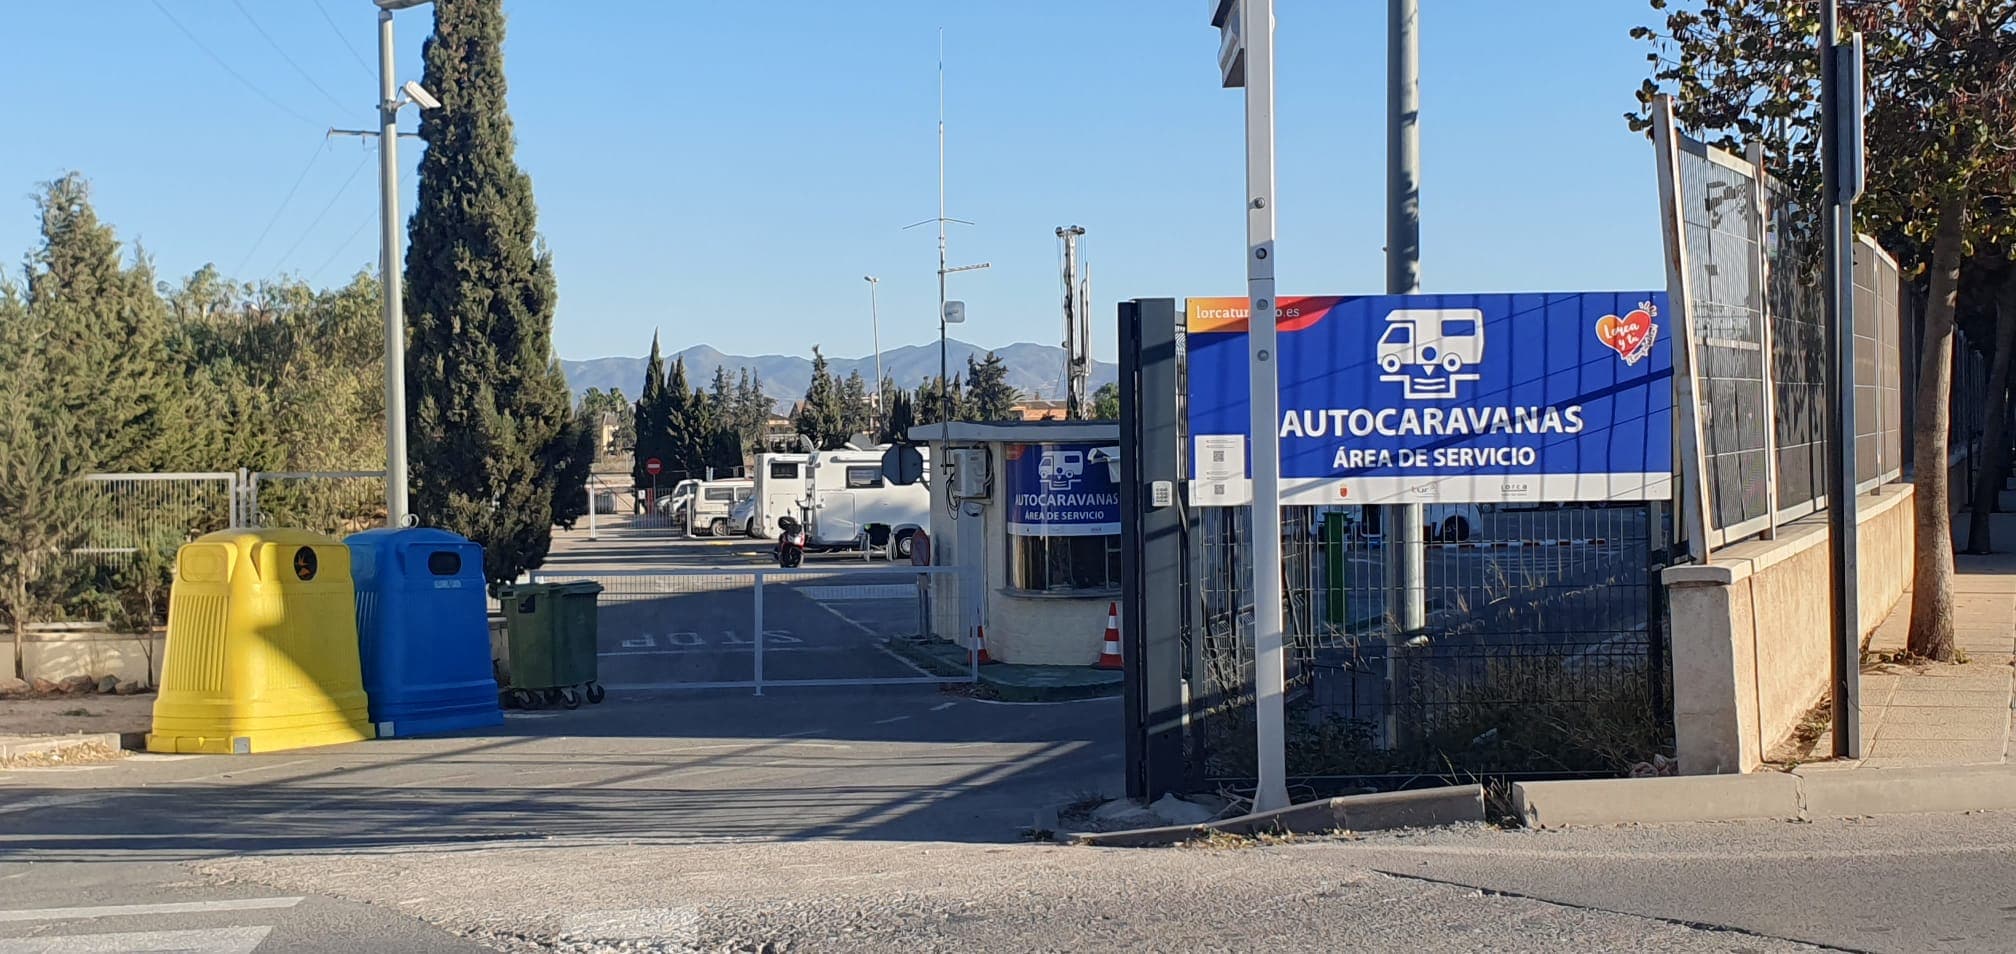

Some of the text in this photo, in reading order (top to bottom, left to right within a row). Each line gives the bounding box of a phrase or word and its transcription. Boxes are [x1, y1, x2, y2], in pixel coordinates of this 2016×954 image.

[1604, 323, 1640, 339] Lorca
[1618, 338, 1626, 351] y
[1279, 405, 1584, 437] AUTOCARAVANAS
[1333, 446, 1536, 468] ÁREA DE SERVICIO
[1015, 493, 1119, 506] AUTOCARAVANAS
[1025, 510, 1105, 520] ÁREA DE SERVICIO
[622, 629, 803, 647] STOP
